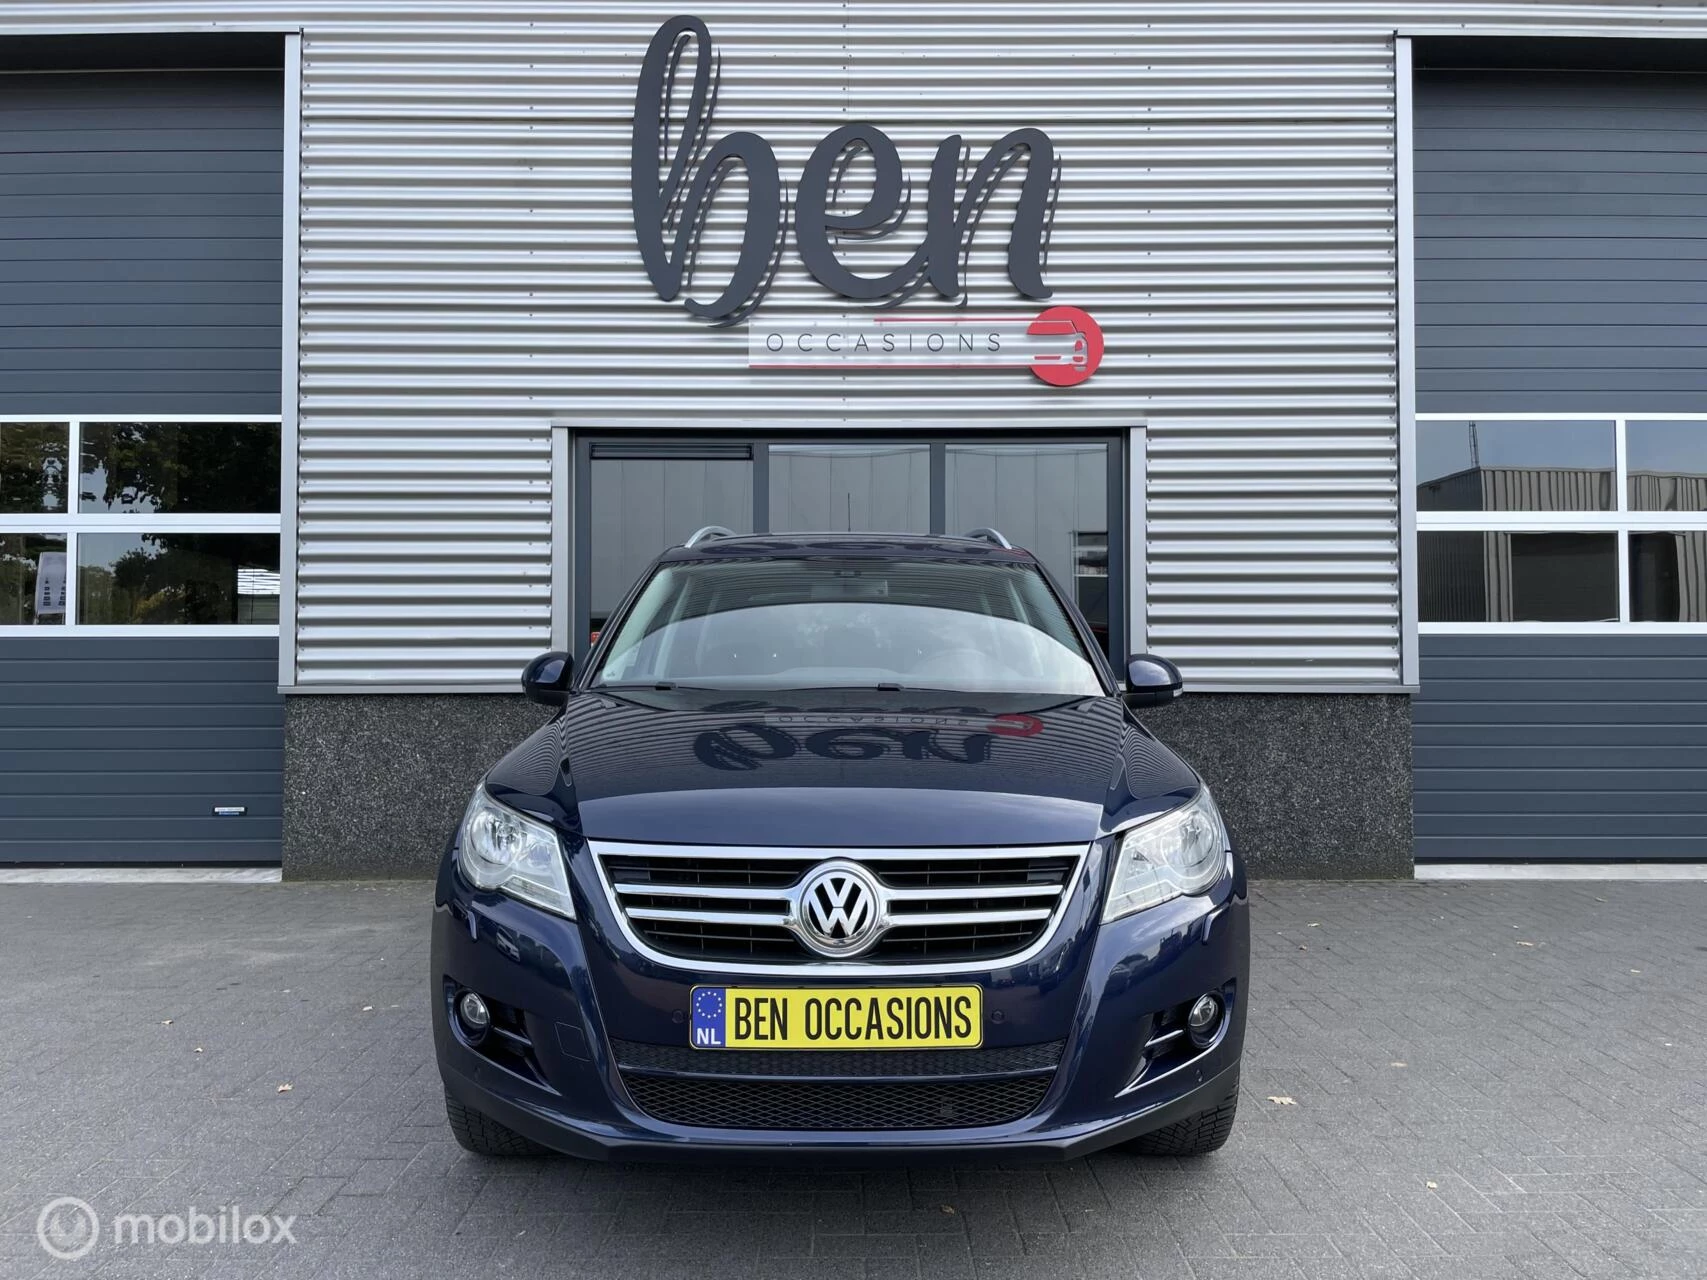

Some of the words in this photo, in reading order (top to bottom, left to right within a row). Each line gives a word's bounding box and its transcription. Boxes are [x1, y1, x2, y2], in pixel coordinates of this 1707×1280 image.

[631, 14, 1059, 324] ben
[766, 332, 1001, 353] OCCASIONS
[806, 876, 868, 938] VW
[696, 1027, 721, 1045] NL
[734, 998, 788, 1041] BEN
[805, 996, 972, 1041] OCCASIONS
